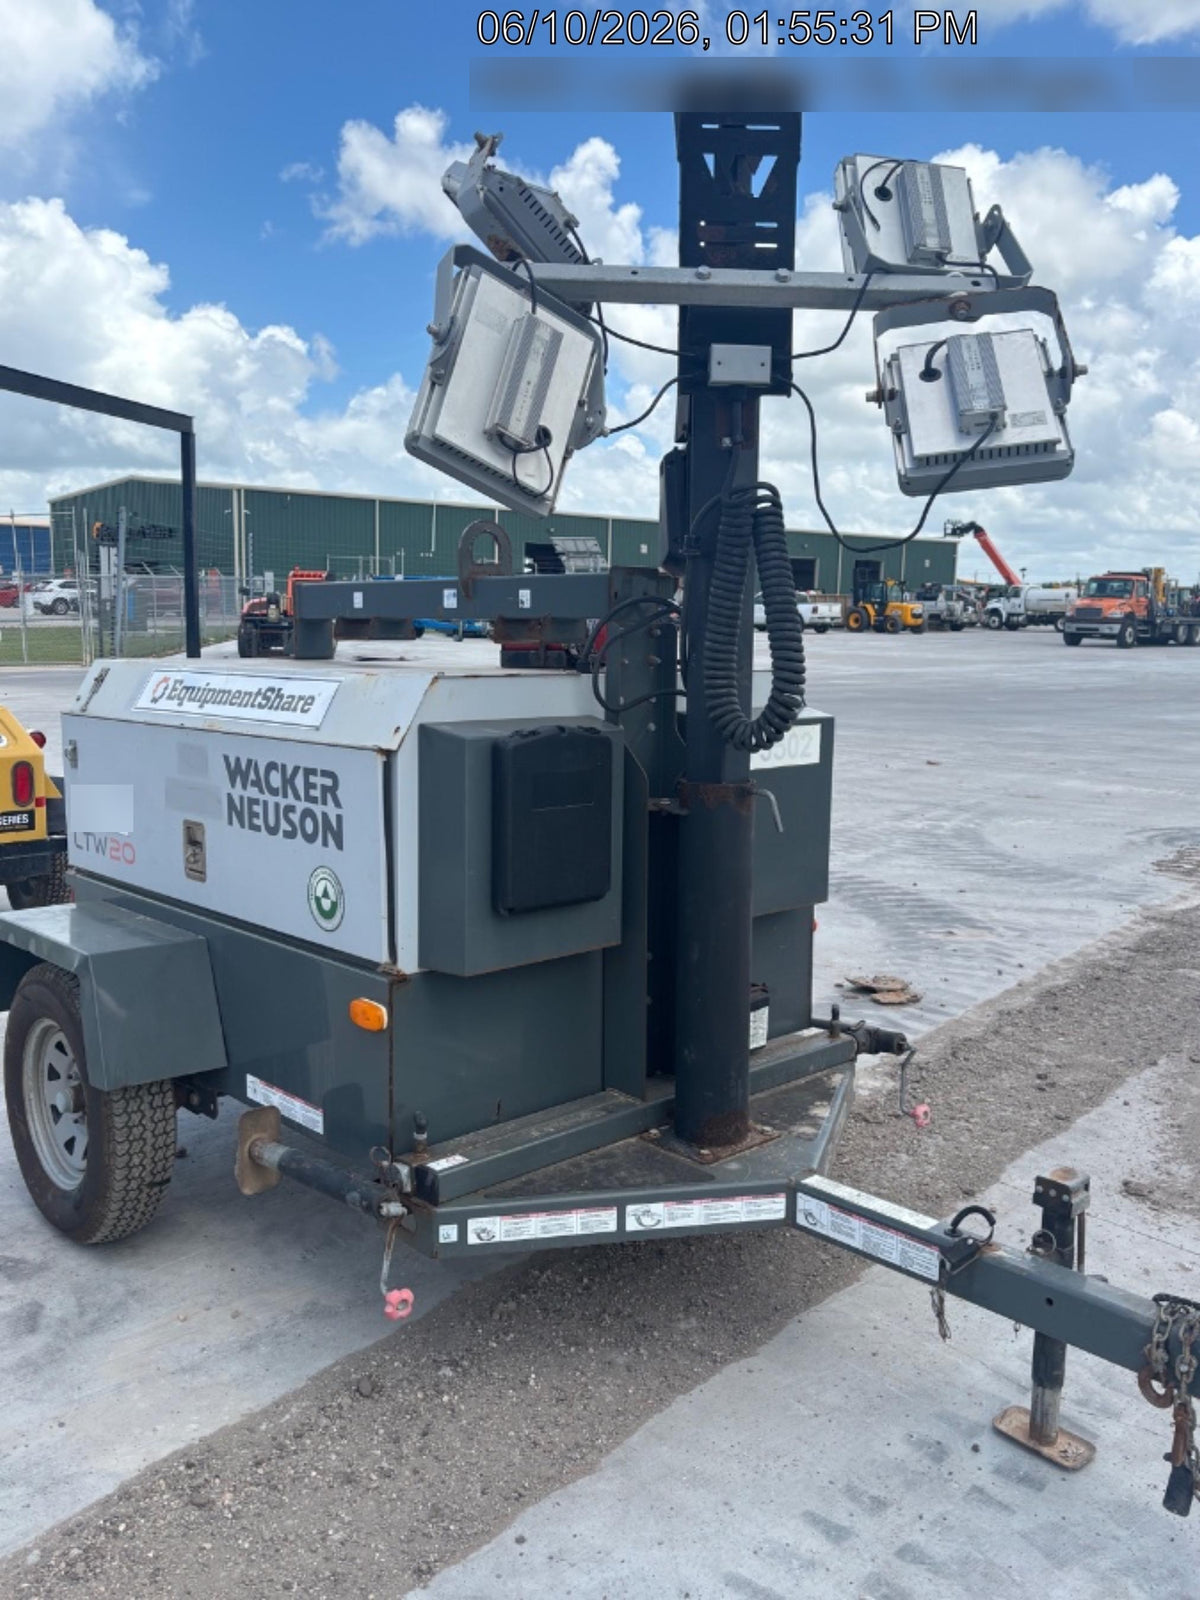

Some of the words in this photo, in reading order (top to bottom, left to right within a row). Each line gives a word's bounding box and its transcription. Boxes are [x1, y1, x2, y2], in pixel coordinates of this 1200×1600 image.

[167, 679, 316, 714] EquipmentShare
[223, 754, 343, 809] WACKER
[227, 792, 344, 851] NEUSON
[73, 831, 136, 865] LTW20
